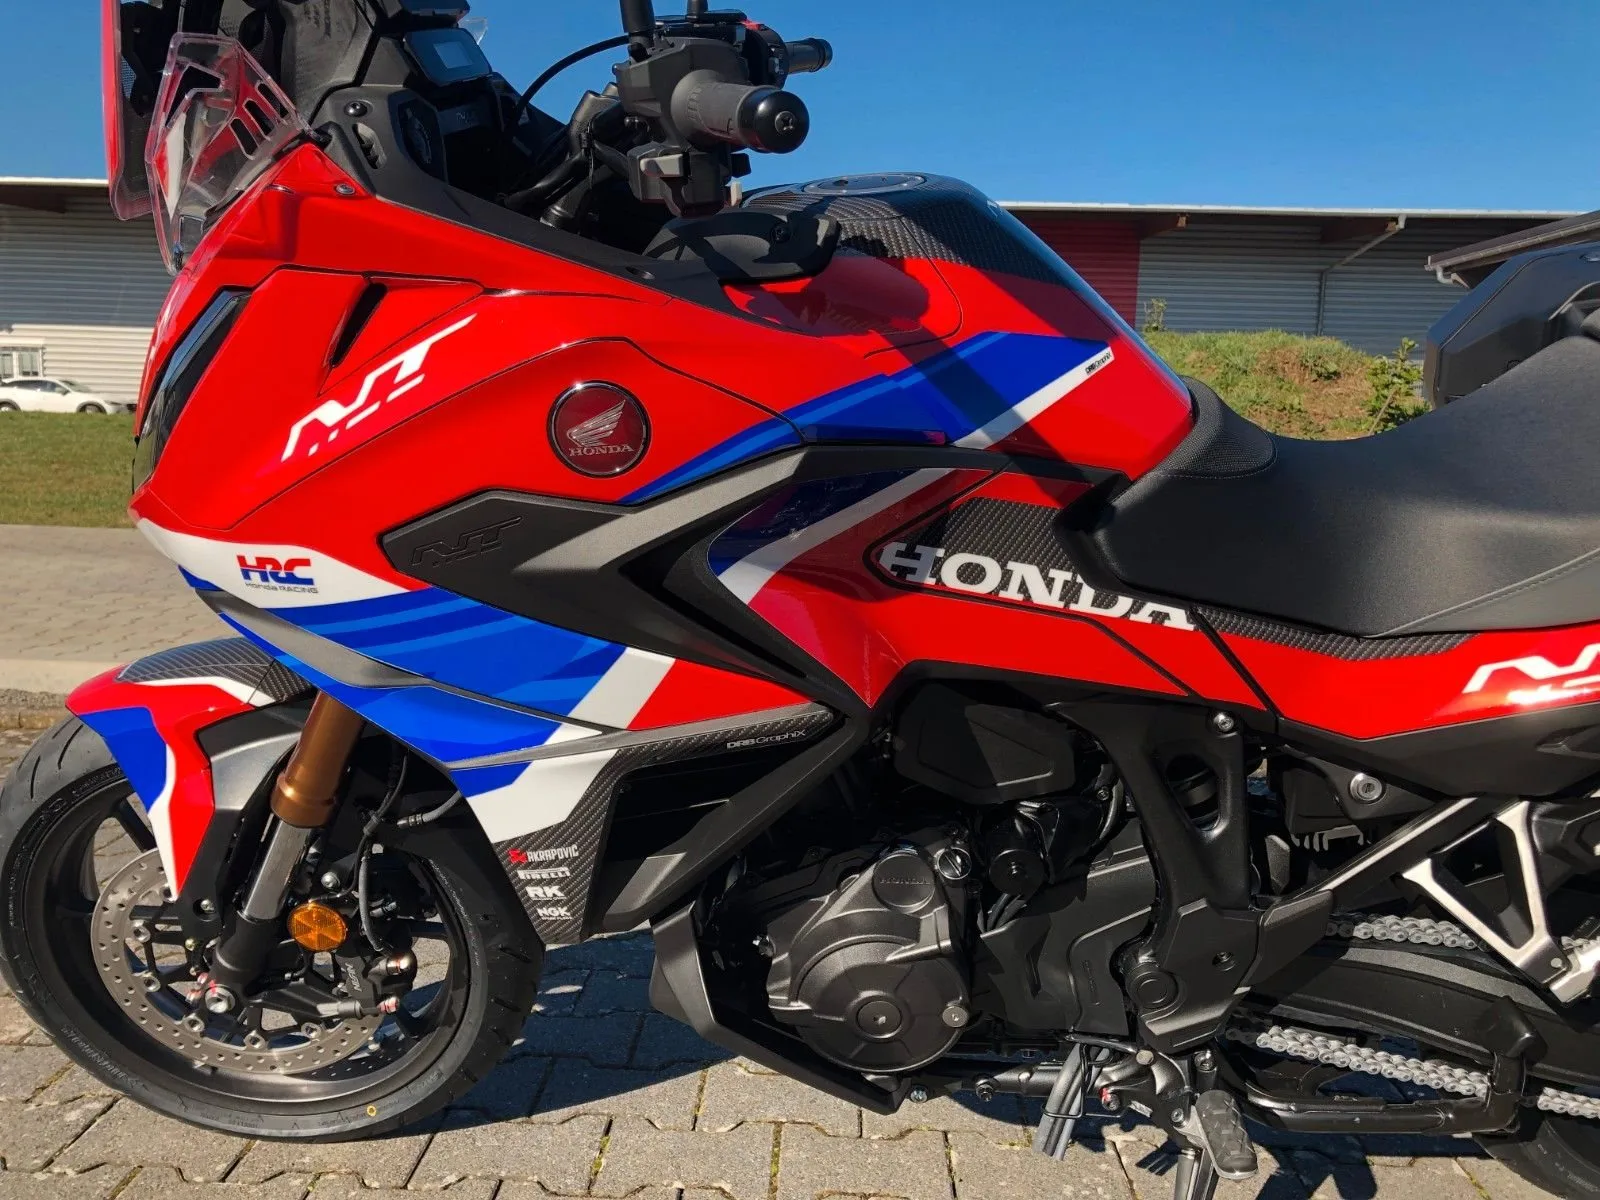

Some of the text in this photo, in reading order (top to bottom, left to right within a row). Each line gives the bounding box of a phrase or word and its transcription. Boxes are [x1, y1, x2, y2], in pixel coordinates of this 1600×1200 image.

[569, 443, 635, 457] HONDA
[236, 555, 315, 586] HRC
[279, 586, 319, 594] RACING
[878, 542, 1195, 631] HONDA
[525, 885, 566, 898] RK
[536, 906, 571, 917] NGK
